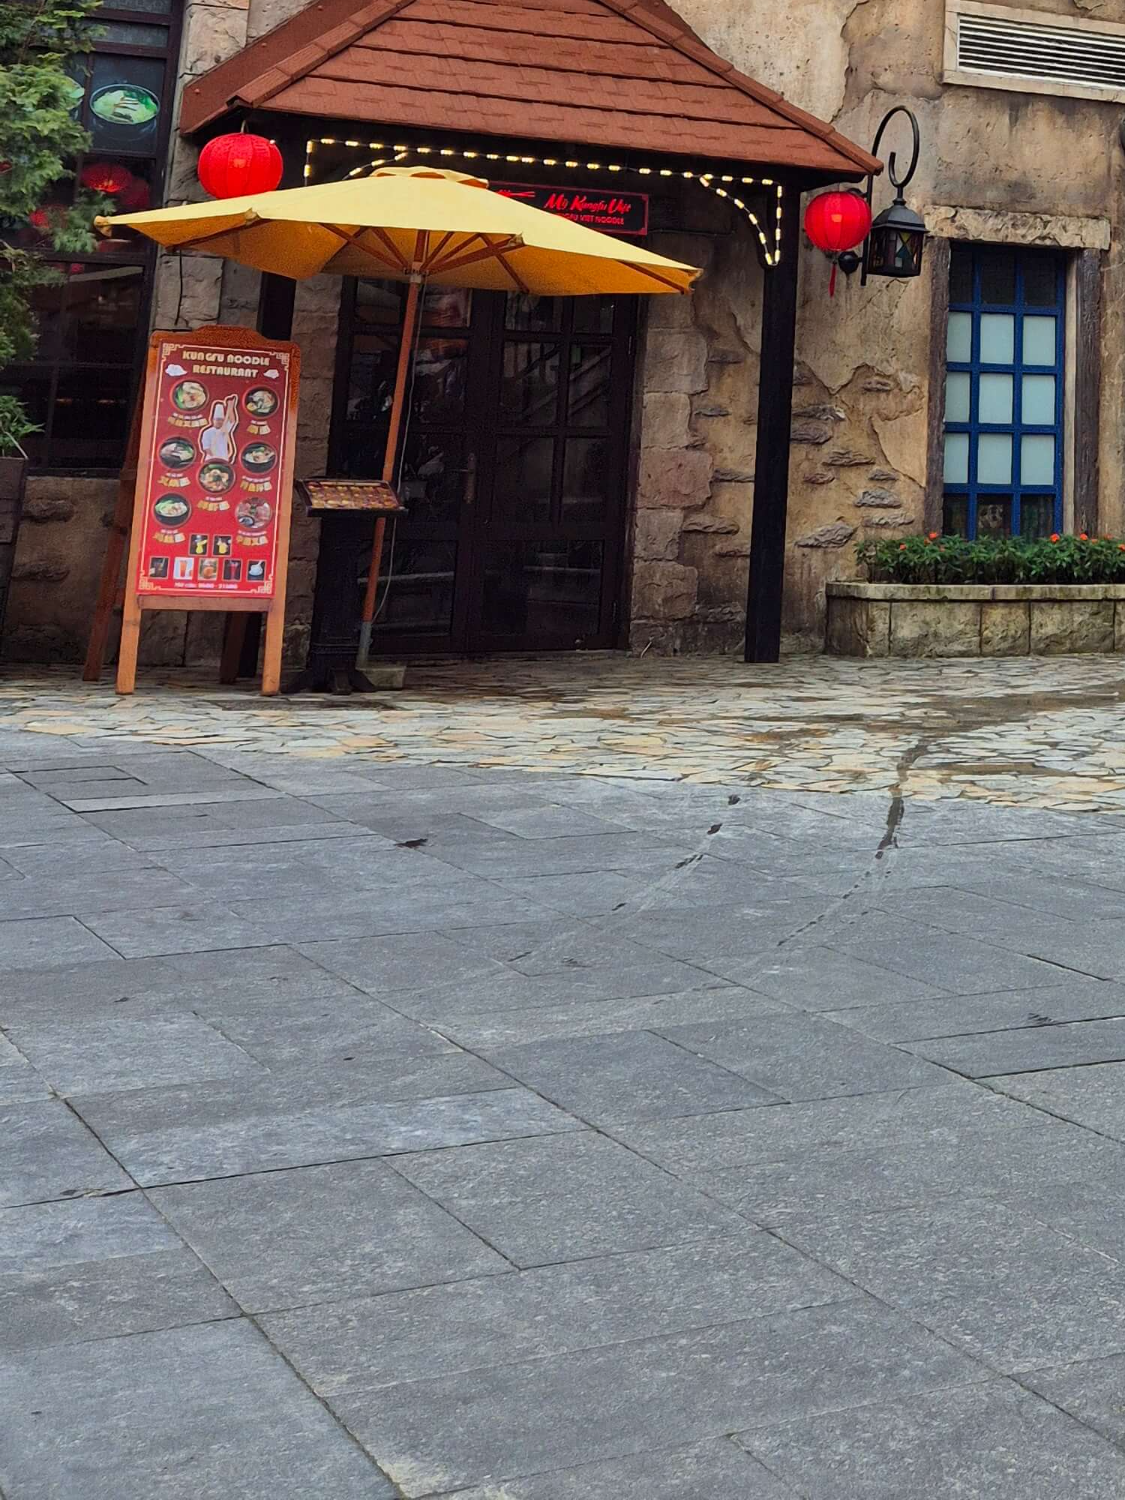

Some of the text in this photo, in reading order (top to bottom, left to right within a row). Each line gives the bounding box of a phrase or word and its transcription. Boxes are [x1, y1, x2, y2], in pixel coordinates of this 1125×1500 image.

[570, 195, 607, 212] Kungfu
[595, 216, 625, 225] NOODLE
[183, 350, 270, 366] KUNGFU NOODLE
[192, 364, 259, 378] RESTAURANT
